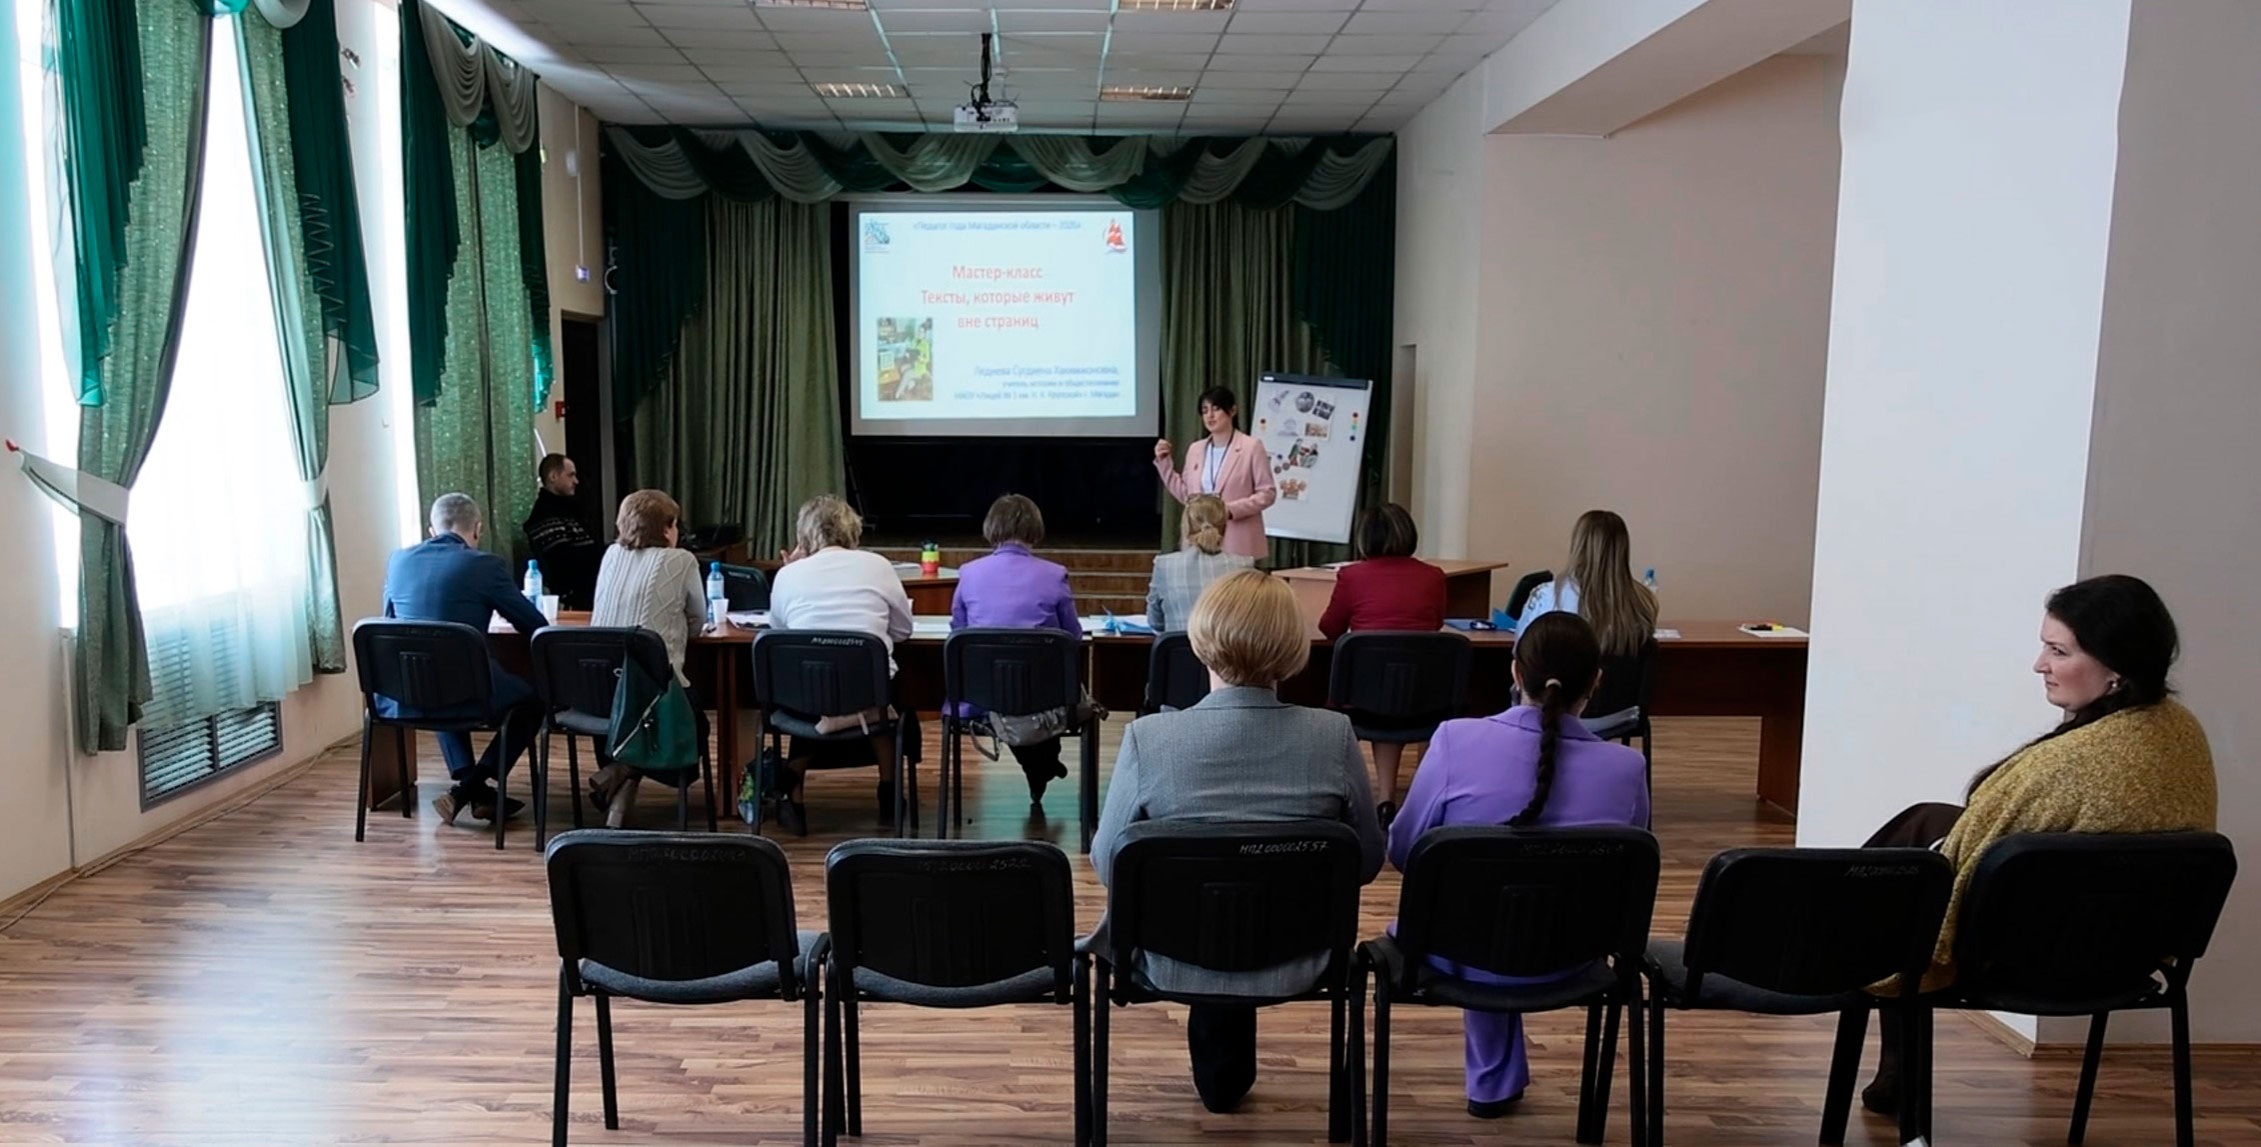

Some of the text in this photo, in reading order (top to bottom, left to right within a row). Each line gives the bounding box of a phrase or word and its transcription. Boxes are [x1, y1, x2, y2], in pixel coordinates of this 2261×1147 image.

[952, 265, 1043, 282] Мастер-класс
[920, 289, 1075, 307] Тексты, которые живут
[957, 316, 1039, 331] вне страниц
